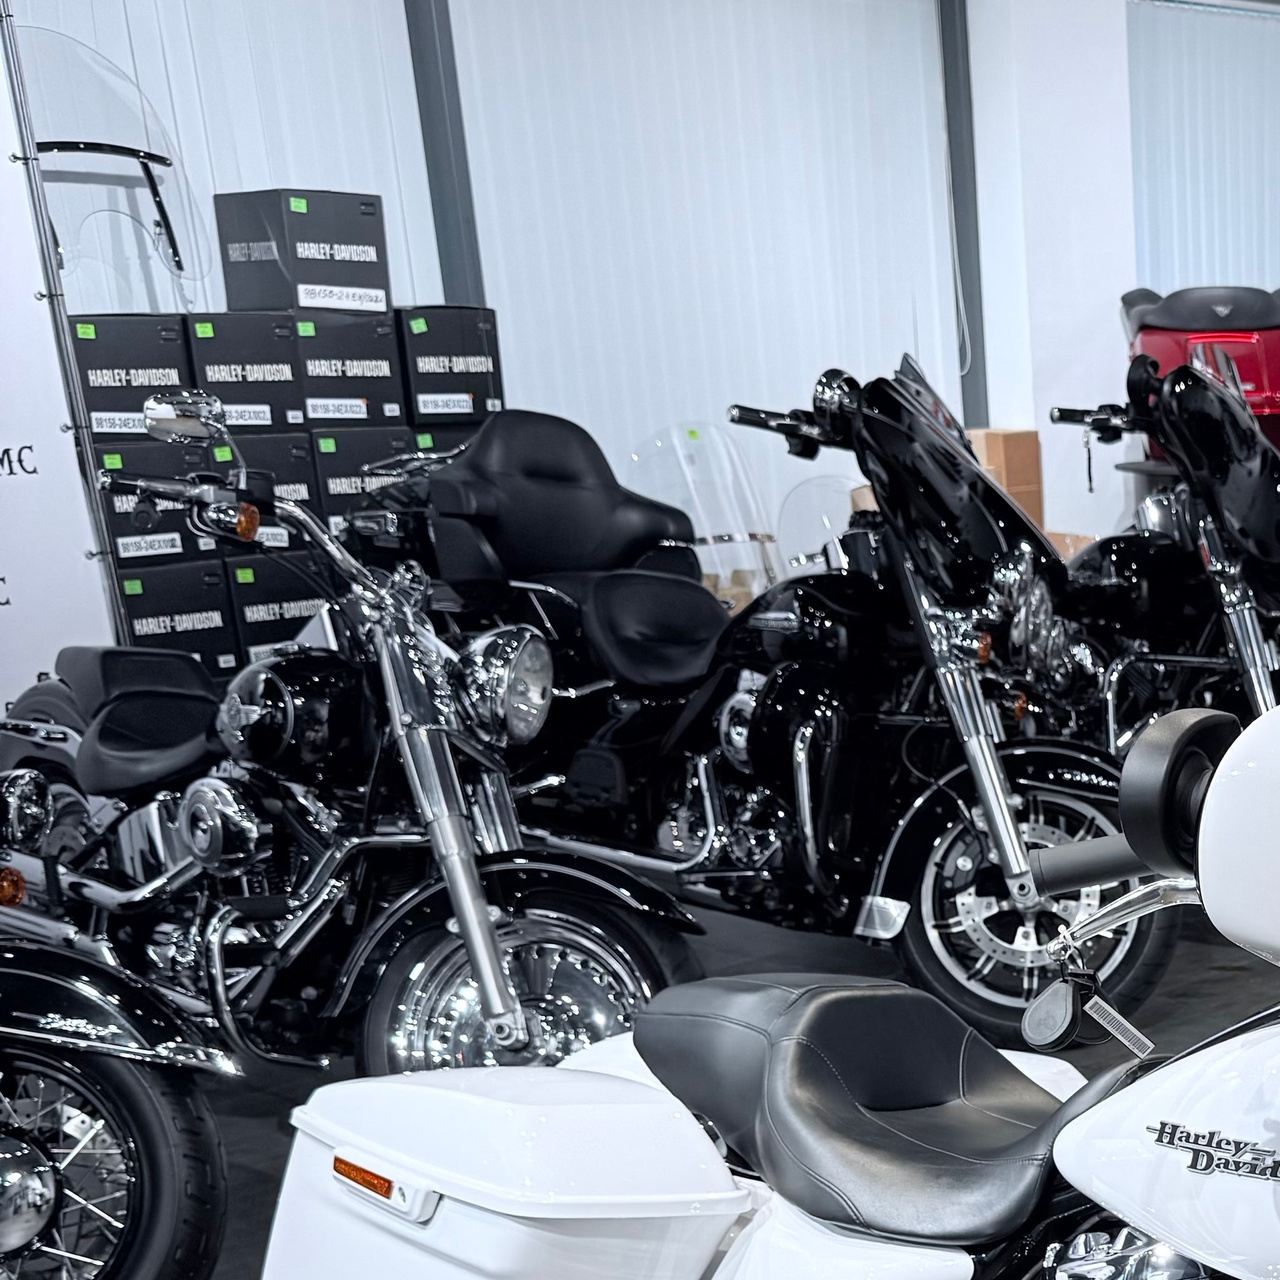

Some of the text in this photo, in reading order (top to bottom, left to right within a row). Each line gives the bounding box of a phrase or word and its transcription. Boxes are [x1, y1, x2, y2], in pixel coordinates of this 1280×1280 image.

[296, 242, 378, 262] HARLEY-DAVIDSON
[205, 364, 294, 382] HARLEY-DAVIDSON
[305, 358, 392, 377] HARLEY-DAVIDSON
[416, 355, 494, 373] HARLEY-DAVIDSON
[87, 368, 181, 387] HARLEY-DAVIDSON
[132, 610, 225, 636] HARLEY-DAVIDSON
[1150, 1120, 1268, 1157] Harley
